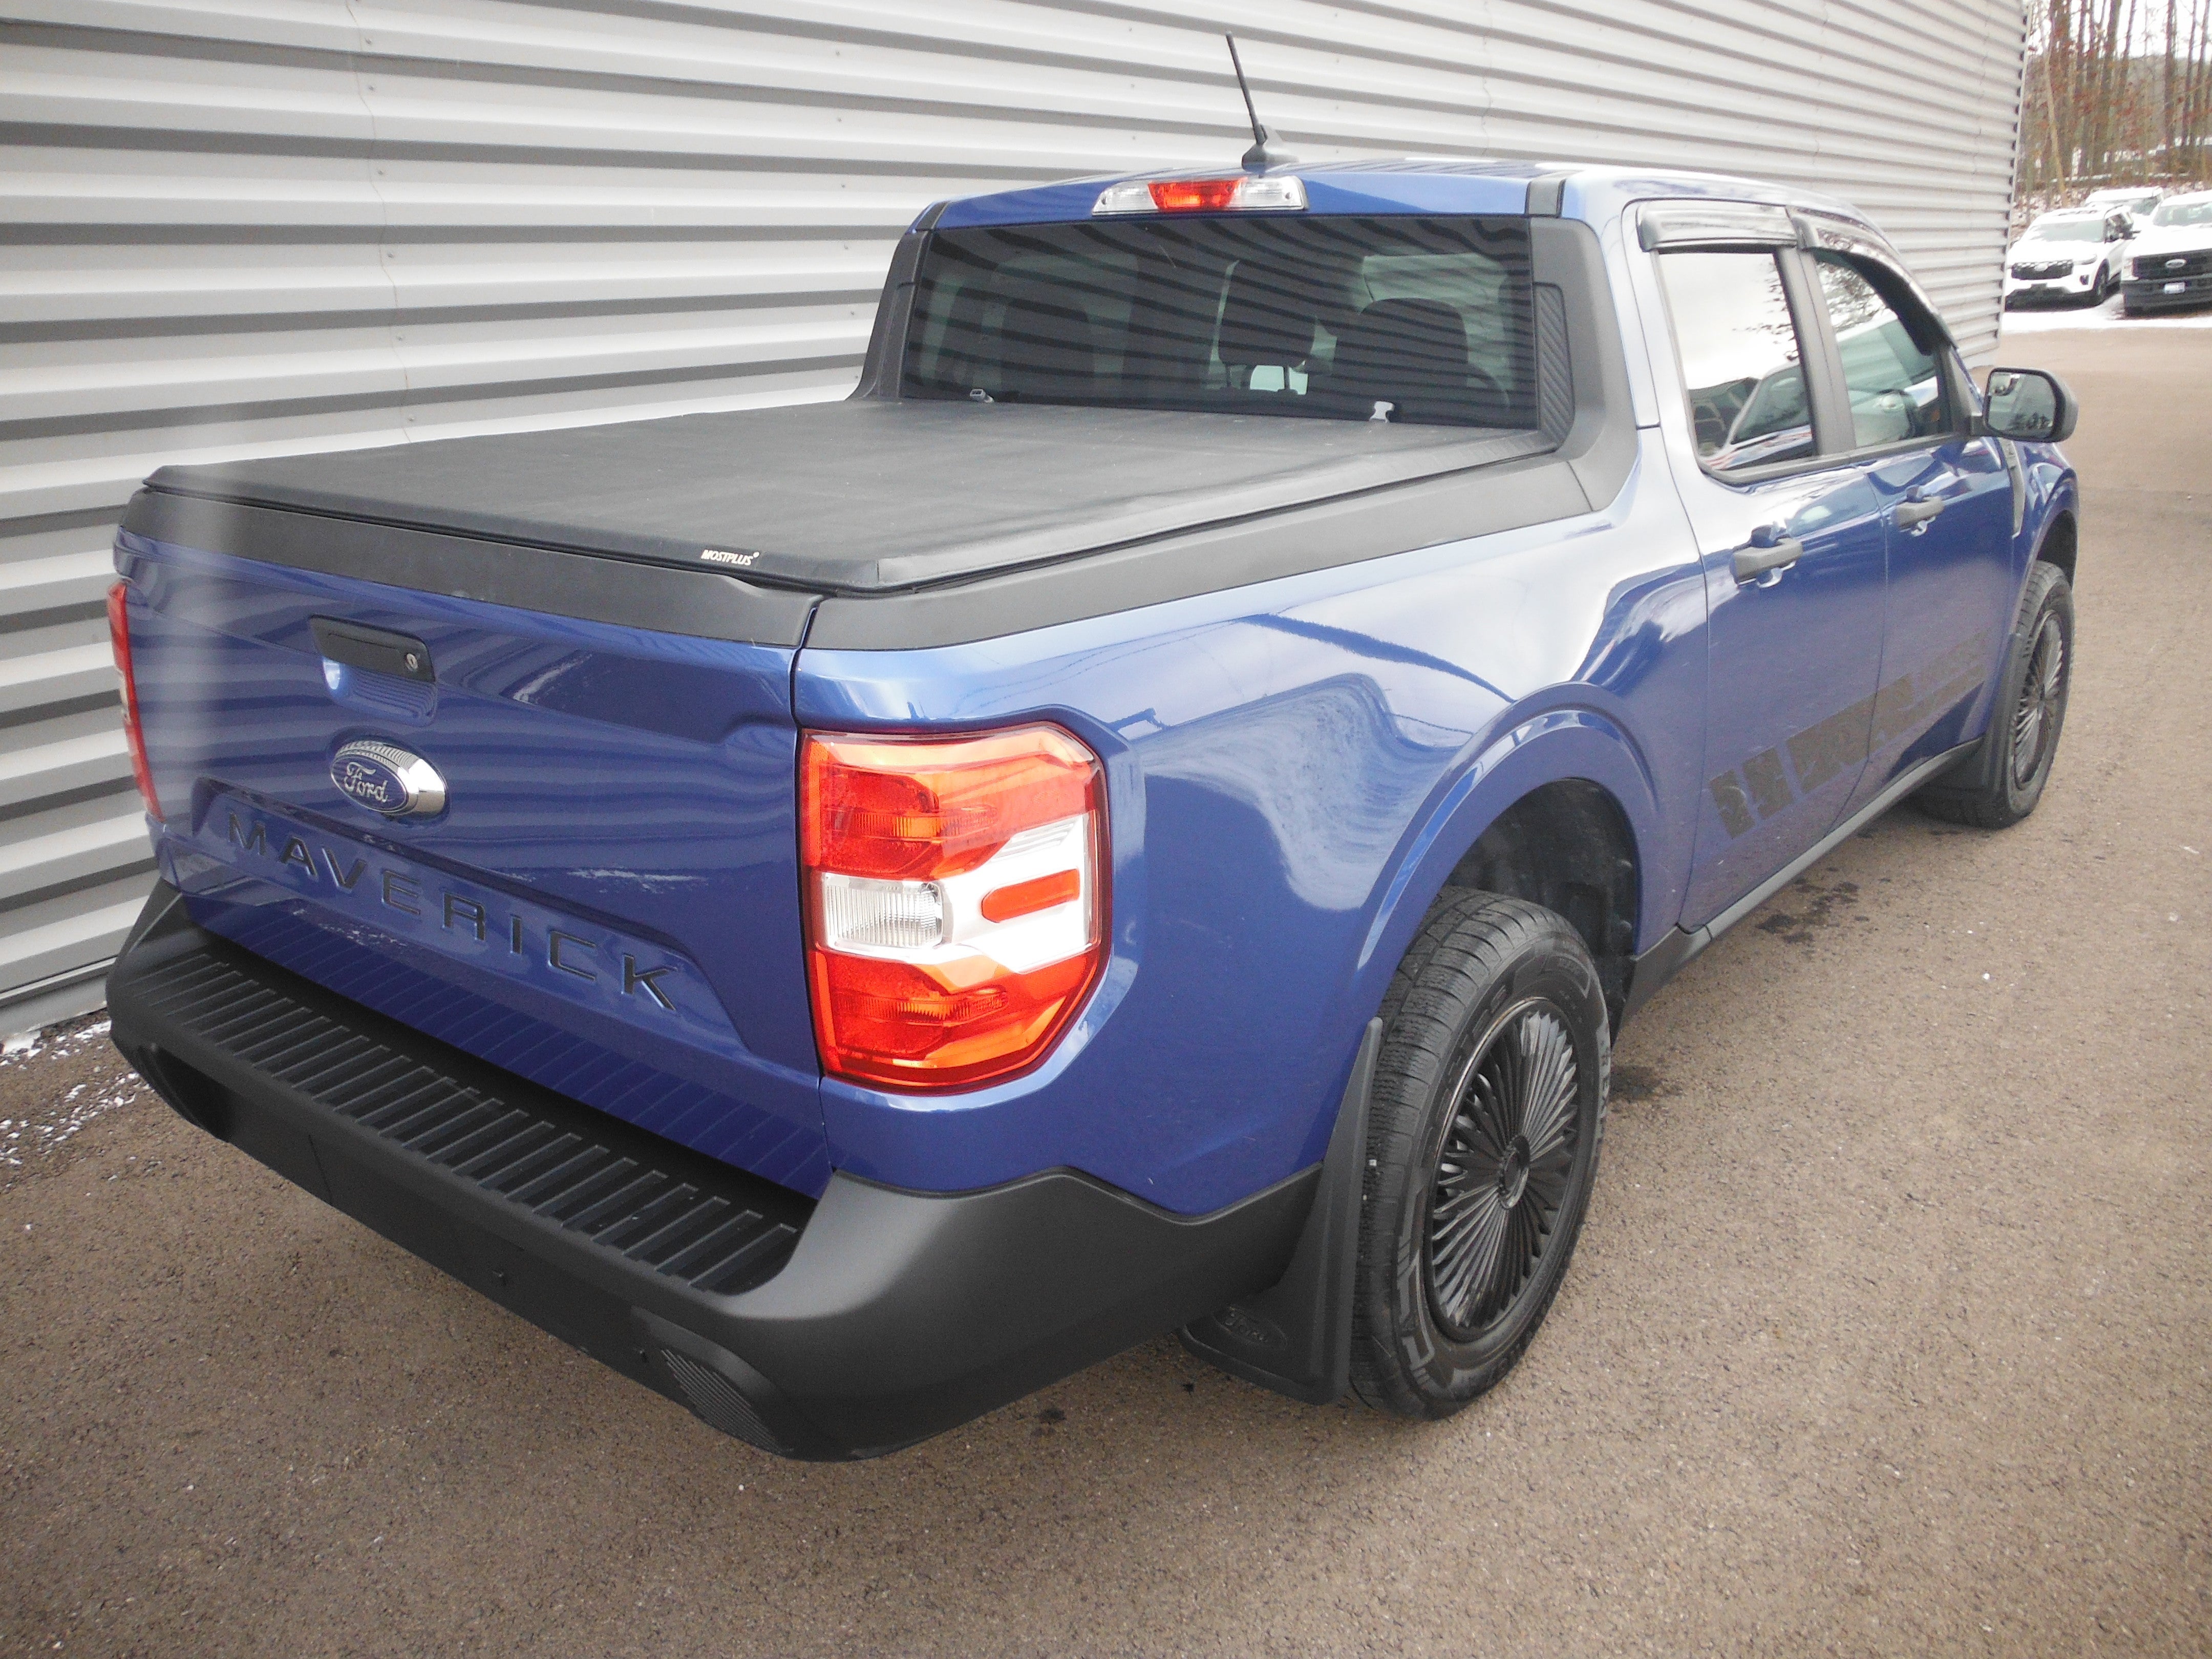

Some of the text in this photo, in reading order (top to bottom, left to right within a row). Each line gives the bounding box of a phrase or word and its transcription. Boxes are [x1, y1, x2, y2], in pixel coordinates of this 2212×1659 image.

[700, 549, 754, 566] MOSTPLUS
[344, 761, 388, 802] Ford
[226, 811, 680, 1011] MAVERICK
